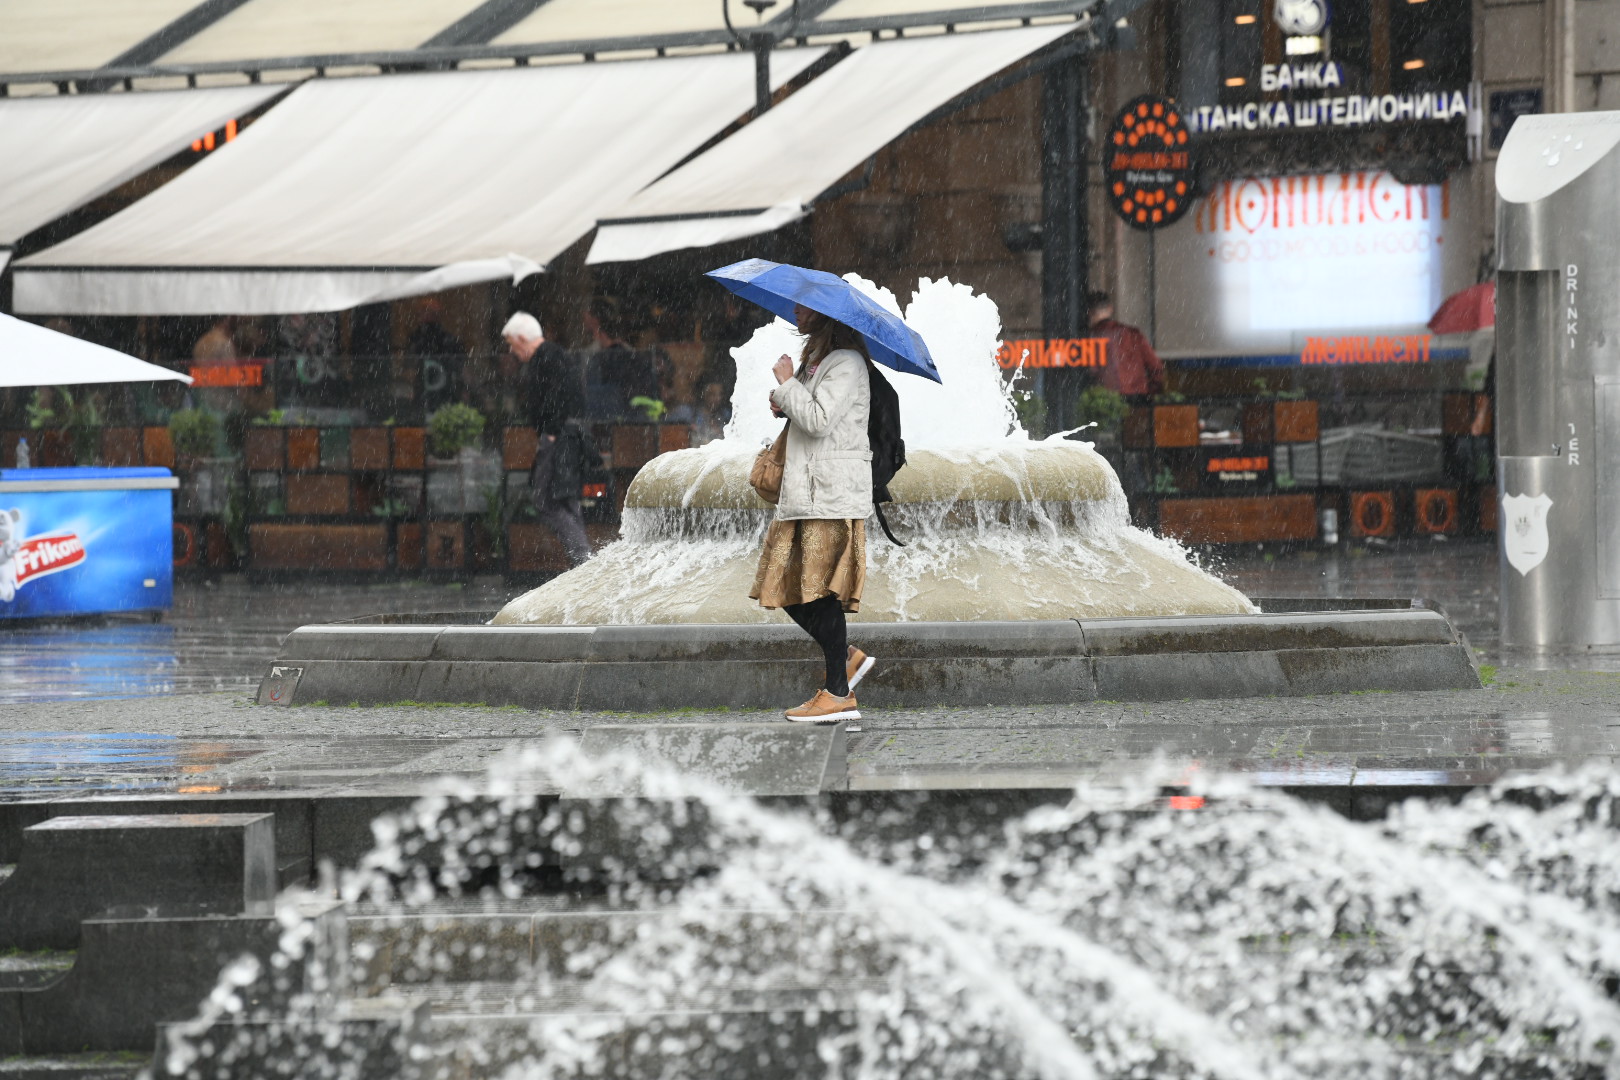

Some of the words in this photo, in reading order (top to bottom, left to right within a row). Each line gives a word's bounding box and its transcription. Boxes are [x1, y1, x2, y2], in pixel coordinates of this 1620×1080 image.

[1261, 60, 1342, 92] БАНКА
[1294, 89, 1468, 127] ШТЕДИОНИЦА
[1219, 238, 1281, 263] GOOD
[995, 337, 1110, 368] ONUMENT
[1301, 334, 1432, 364] MONUMENT
[14, 537, 83, 576] Frikom
